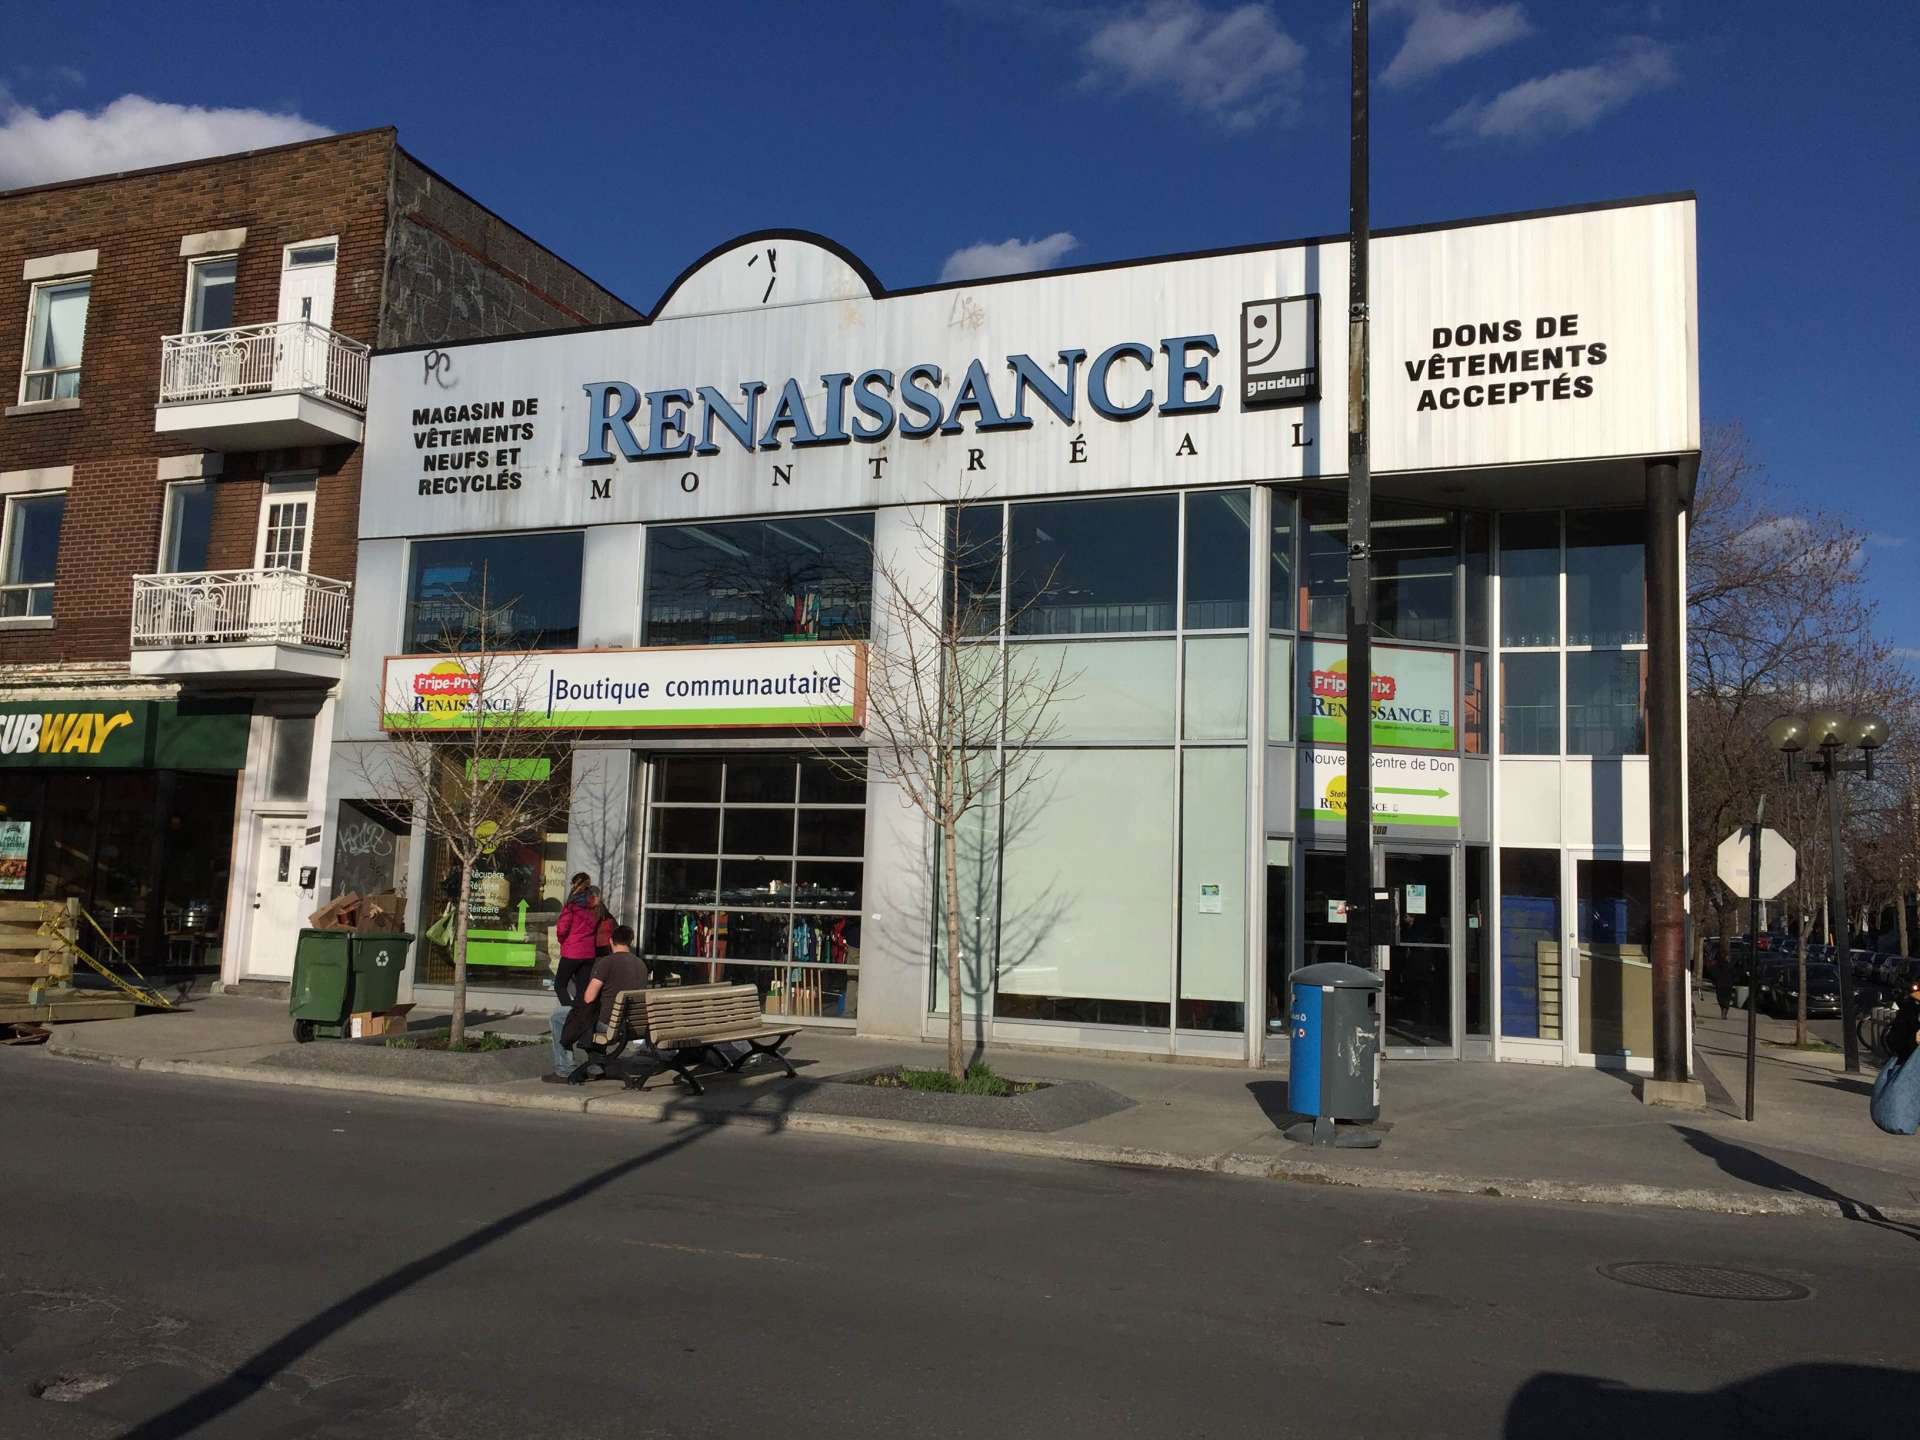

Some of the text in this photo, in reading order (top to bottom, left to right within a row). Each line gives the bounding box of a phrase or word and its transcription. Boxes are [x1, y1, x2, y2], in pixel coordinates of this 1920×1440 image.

[1432, 314, 1579, 349] DONS DE
[1404, 342, 1608, 382] VÊTEMENTS
[1247, 372, 1315, 397] goodwill
[1416, 374, 1594, 412] ACCEPTÉS
[412, 398, 539, 426] MAGASIN DE
[578, 333, 1223, 466] RENAISSANCE
[413, 422, 534, 449] VÊTEMENTS
[423, 448, 521, 472] NEUFS ET
[590, 423, 1313, 500] MONTRÉAL
[418, 467, 522, 495] RECYCLÉS
[555, 671, 841, 705] Boutique communautaire
[1314, 675, 1391, 693] Friprix
[1312, 697, 1432, 723] RENSSANCE
[1305, 751, 1346, 766] Nouve
[1411, 758, 1426, 771] de
[1430, 758, 1455, 772] Don
